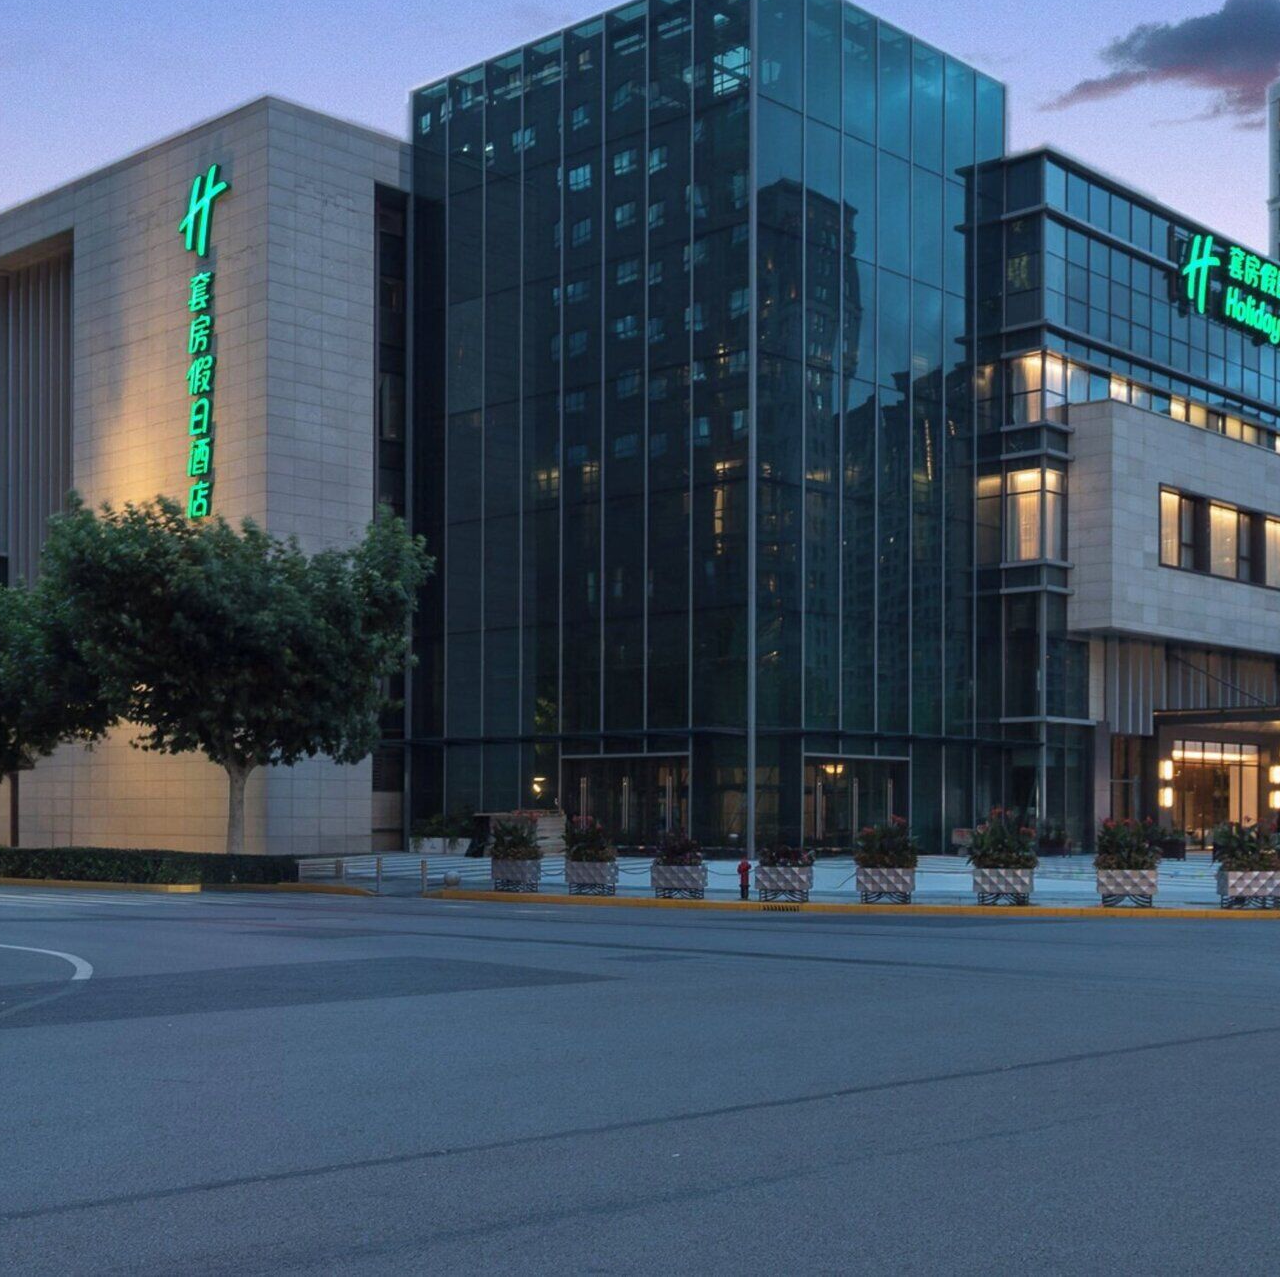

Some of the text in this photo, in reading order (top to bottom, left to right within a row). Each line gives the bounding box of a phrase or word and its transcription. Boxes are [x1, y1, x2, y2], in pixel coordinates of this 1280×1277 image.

[1225, 286, 1280, 344] Holiday
[186, 271, 214, 519] 套房假日酒店
